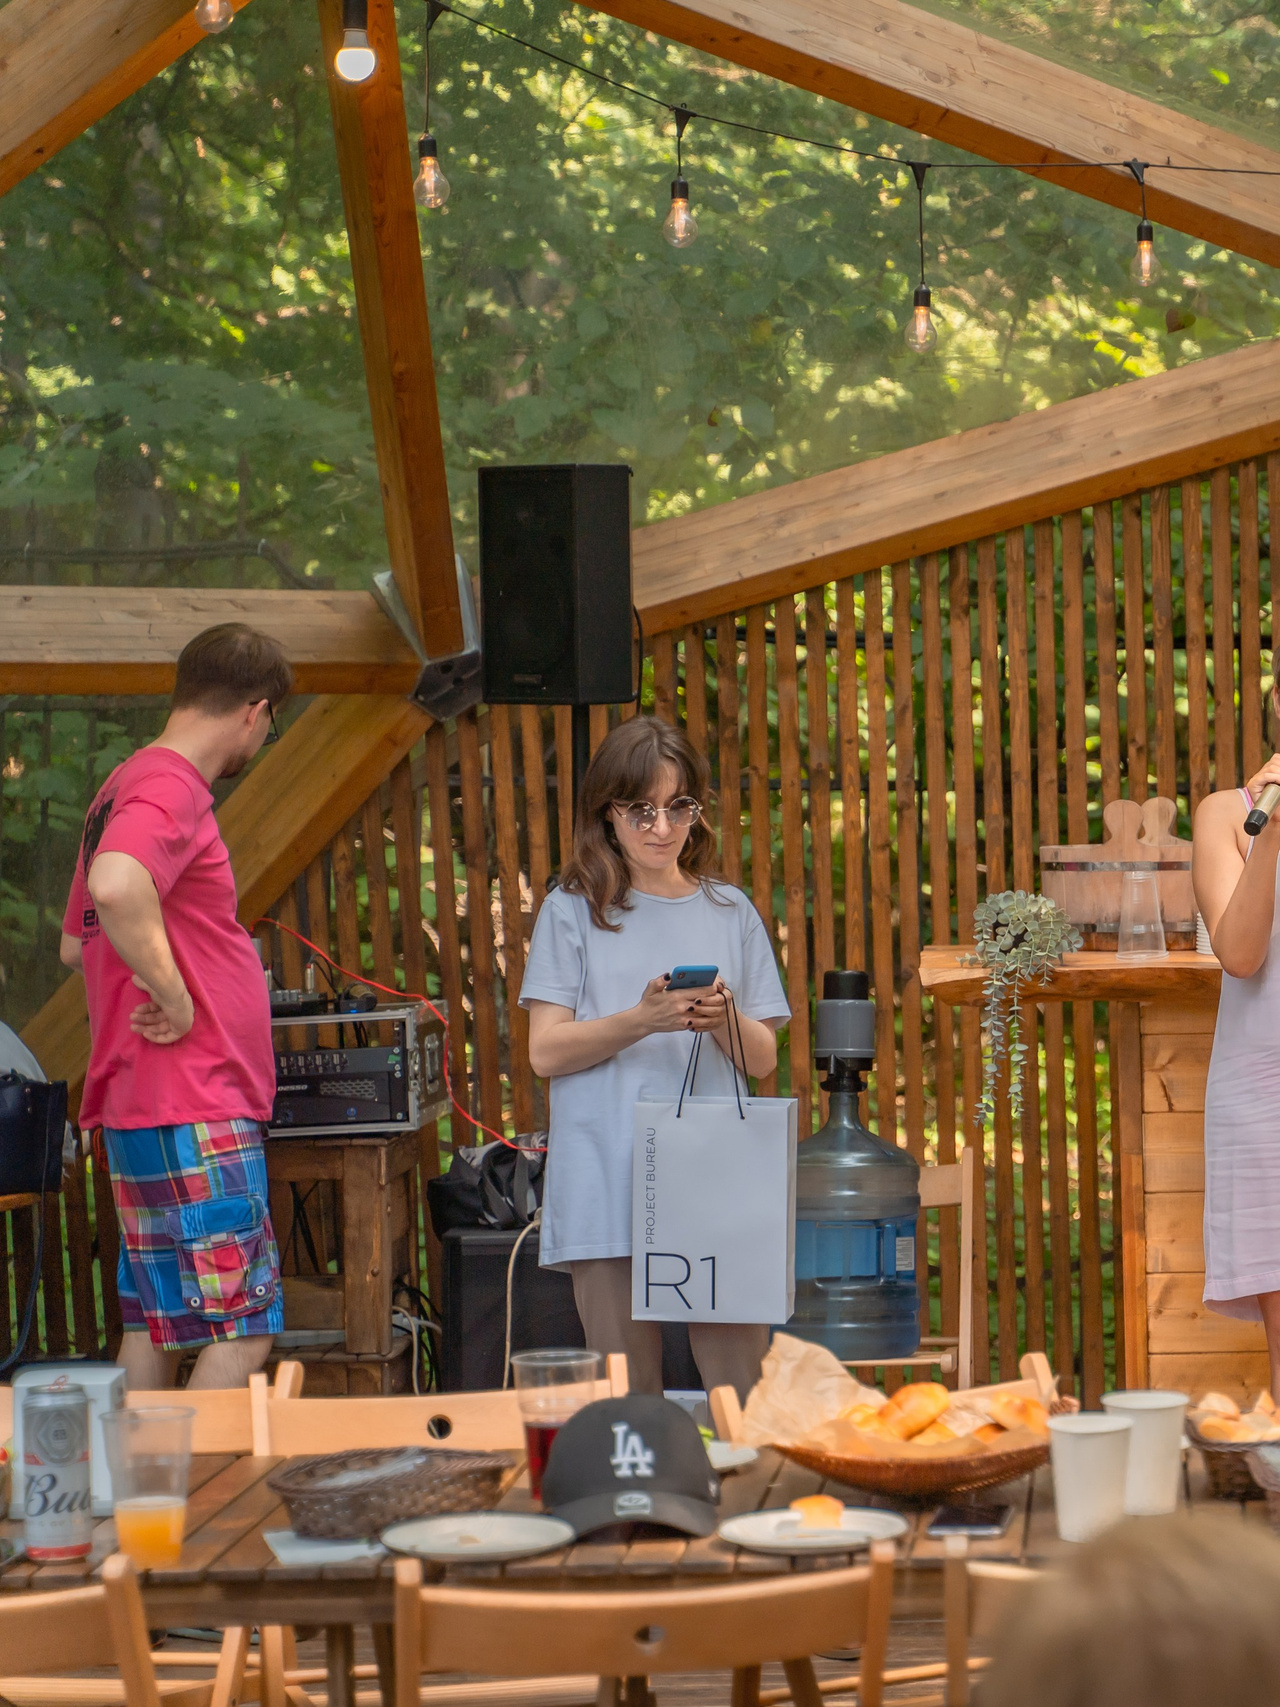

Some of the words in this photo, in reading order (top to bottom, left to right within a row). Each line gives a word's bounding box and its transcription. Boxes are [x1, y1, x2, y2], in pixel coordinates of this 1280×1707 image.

[646, 1127, 656, 1182] BUREAU
[645, 1185, 656, 1245] PROJECT
[645, 1252, 716, 1310] R1
[609, 1421, 656, 1478] LA
